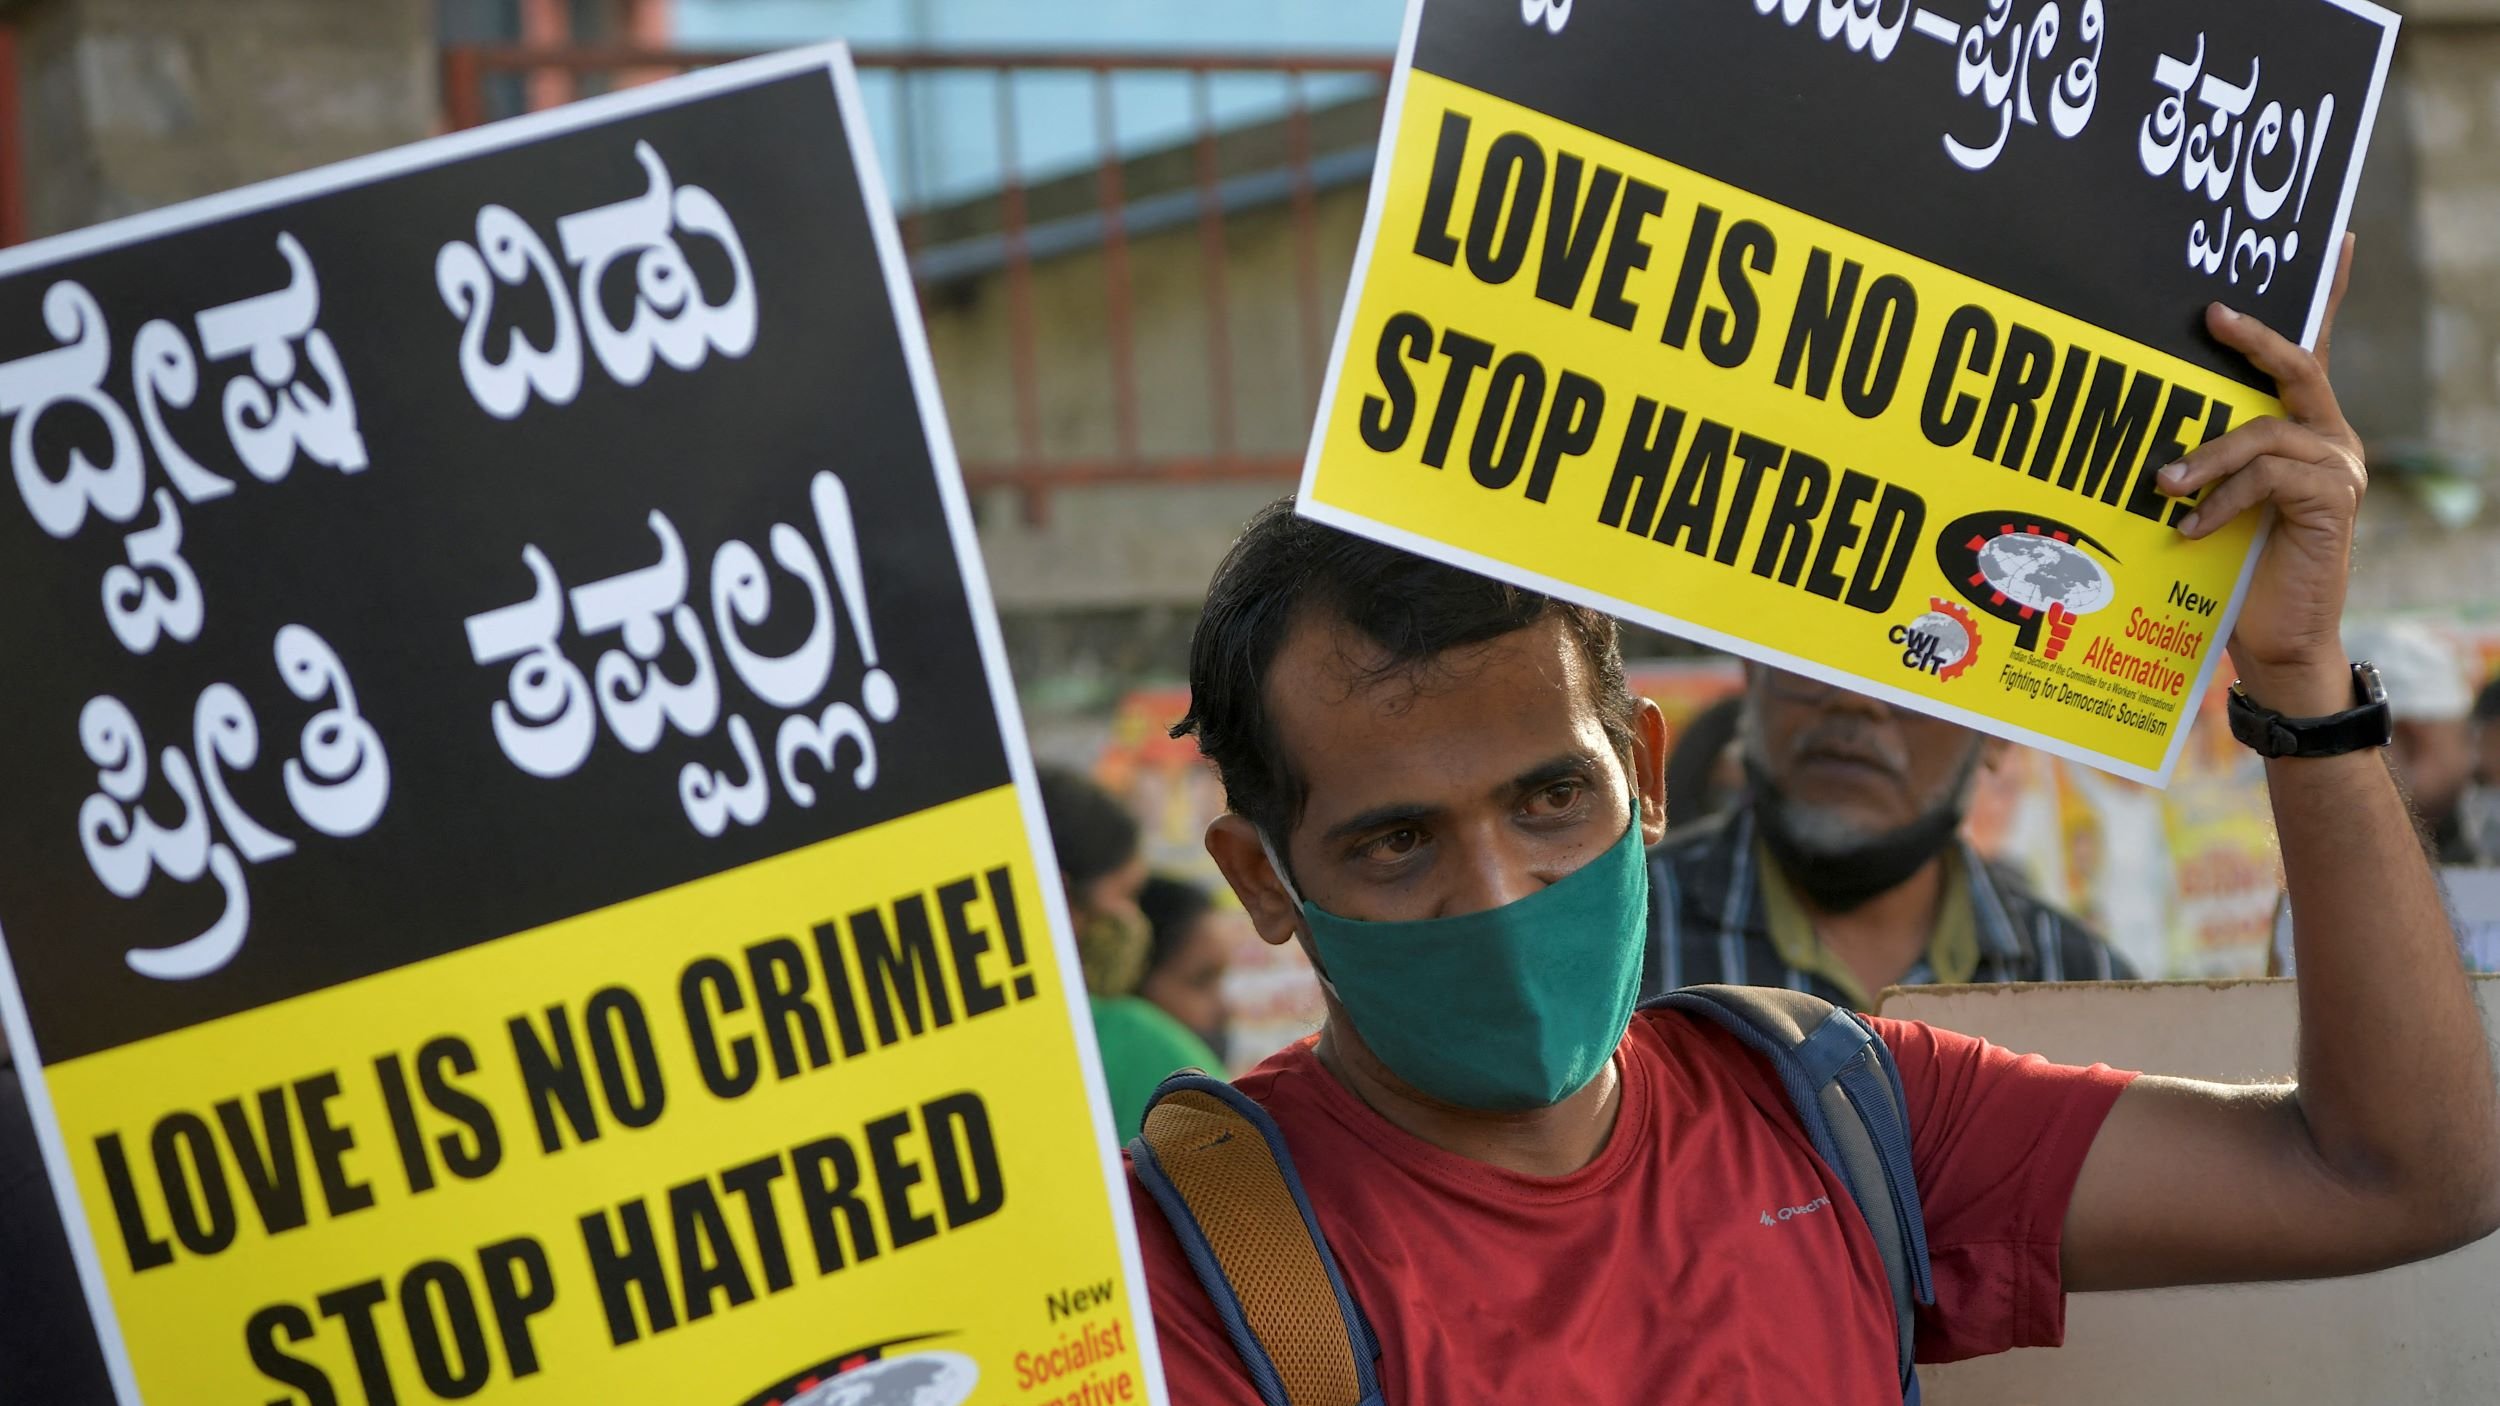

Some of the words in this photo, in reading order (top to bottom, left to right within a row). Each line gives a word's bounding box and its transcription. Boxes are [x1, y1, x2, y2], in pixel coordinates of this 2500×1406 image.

[2138, 31, 2334, 295] ತಪ್ಪಲ್ಲ!
[1412, 110, 1668, 332] LOVE
[1660, 204, 1776, 370] IS
[1773, 246, 1918, 419] NO
[0, 232, 370, 654] ದ್ವೇಷ
[434, 140, 759, 419] ಬಿಡು
[1359, 312, 1605, 505] STOP
[1597, 395, 1926, 614] HATRED
[2125, 606, 2203, 660] Socialist
[2167, 579, 2218, 617] New
[1888, 624, 1940, 655] CWI
[1902, 648, 1948, 676] CIT
[2009, 648, 2028, 663] Indian
[2026, 654, 2049, 671] Section
[2055, 662, 2067, 676] the
[2066, 667, 2098, 686] Committee
[2097, 677, 2107, 689] for
[2081, 635, 2186, 697] Alternative
[79, 624, 390, 979] ಪ್ರೀತಿ
[464, 470, 899, 837] ತಪ್ಪಲ್ಲ!
[1999, 664, 2041, 699] Fighting
[2040, 676, 2059, 700] for
[2056, 682, 2117, 720] Democratic
[2116, 702, 2168, 737] Socialism
[93, 1070, 376, 1274] LOVE
[373, 1035, 503, 1195] IS
[507, 986, 666, 1155] NO
[679, 866, 1036, 1100] CRIME!
[244, 1236, 556, 1406] STOP
[579, 1091, 1005, 1347] HATRED
[1045, 1277, 1114, 1324] New
[1014, 1317, 1126, 1391] Socialist
